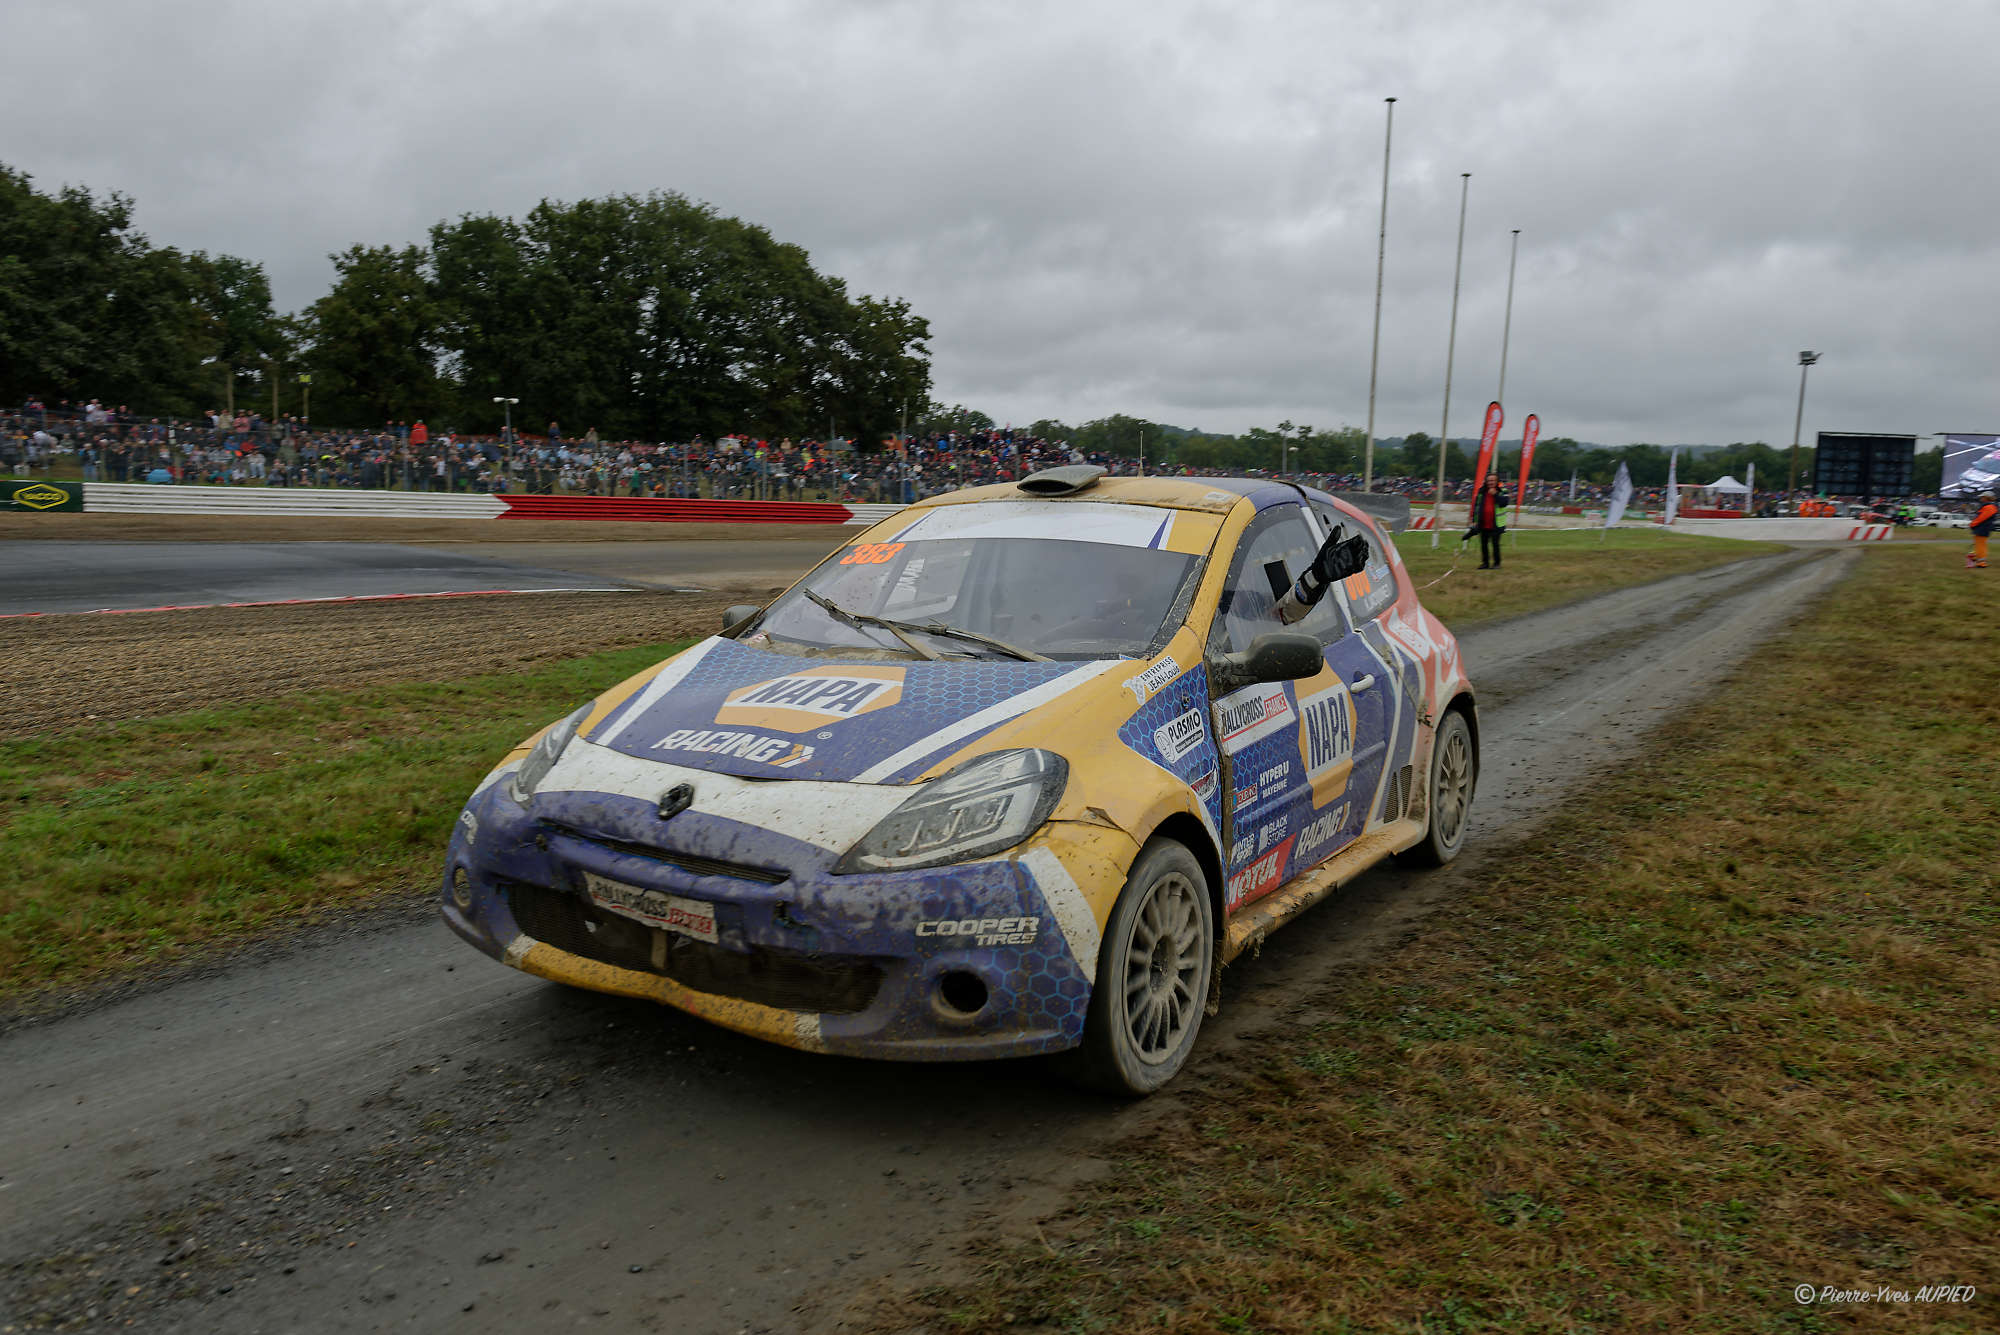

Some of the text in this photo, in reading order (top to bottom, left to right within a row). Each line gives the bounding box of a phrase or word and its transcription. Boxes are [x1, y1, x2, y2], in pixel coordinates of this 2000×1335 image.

[741, 679, 884, 713] NAPA
[1168, 711, 1201, 742] PLASMO
[1222, 696, 1265, 736] RALLYCROSS
[1305, 692, 1350, 770] NAPA
[650, 729, 791, 763] RACING
[1267, 826, 1288, 846] STORE
[1268, 814, 1288, 833] BLACK
[1295, 806, 1343, 860] RACING
[1228, 851, 1280, 905] MOTUL
[915, 917, 1040, 937] COOPER
[975, 932, 1038, 946] TIRES
